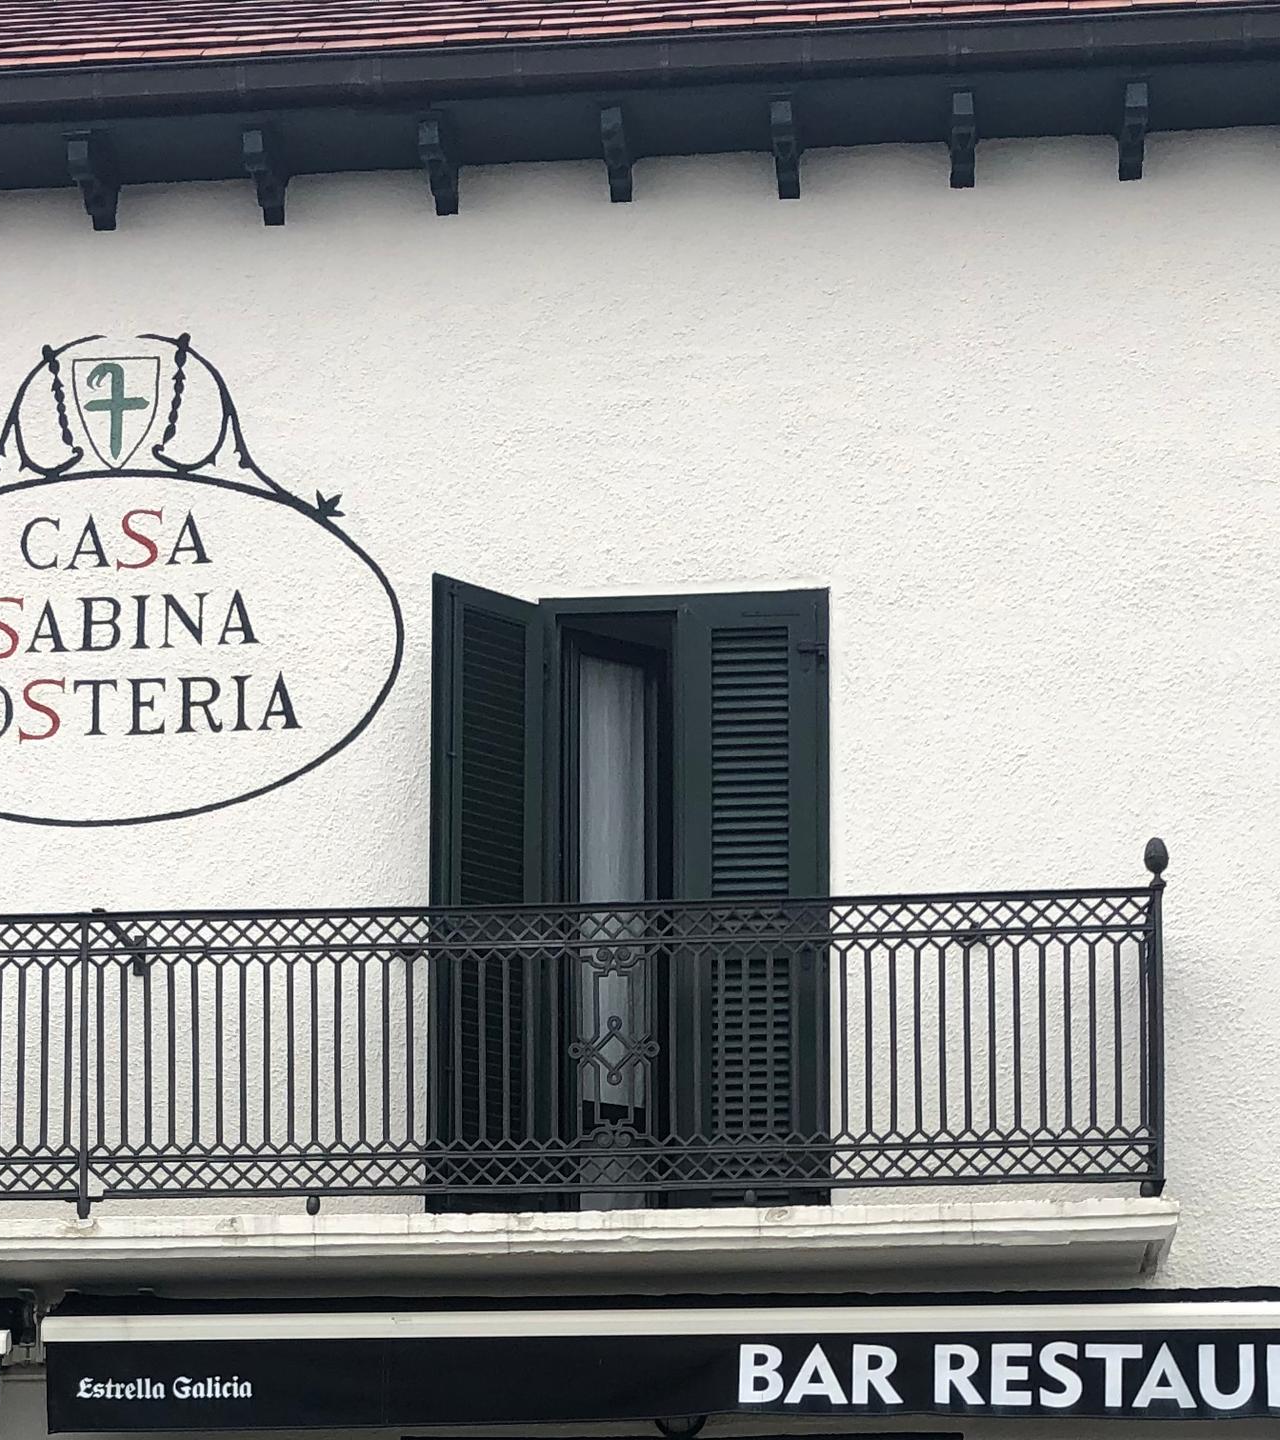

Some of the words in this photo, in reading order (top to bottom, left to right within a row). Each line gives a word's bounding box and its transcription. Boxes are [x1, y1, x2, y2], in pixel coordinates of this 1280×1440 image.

[20, 506, 213, 571] CASA
[76, 1376, 166, 1400] Estrella
[173, 1376, 253, 1399] Galicia
[737, 1342, 903, 1406] BAR
